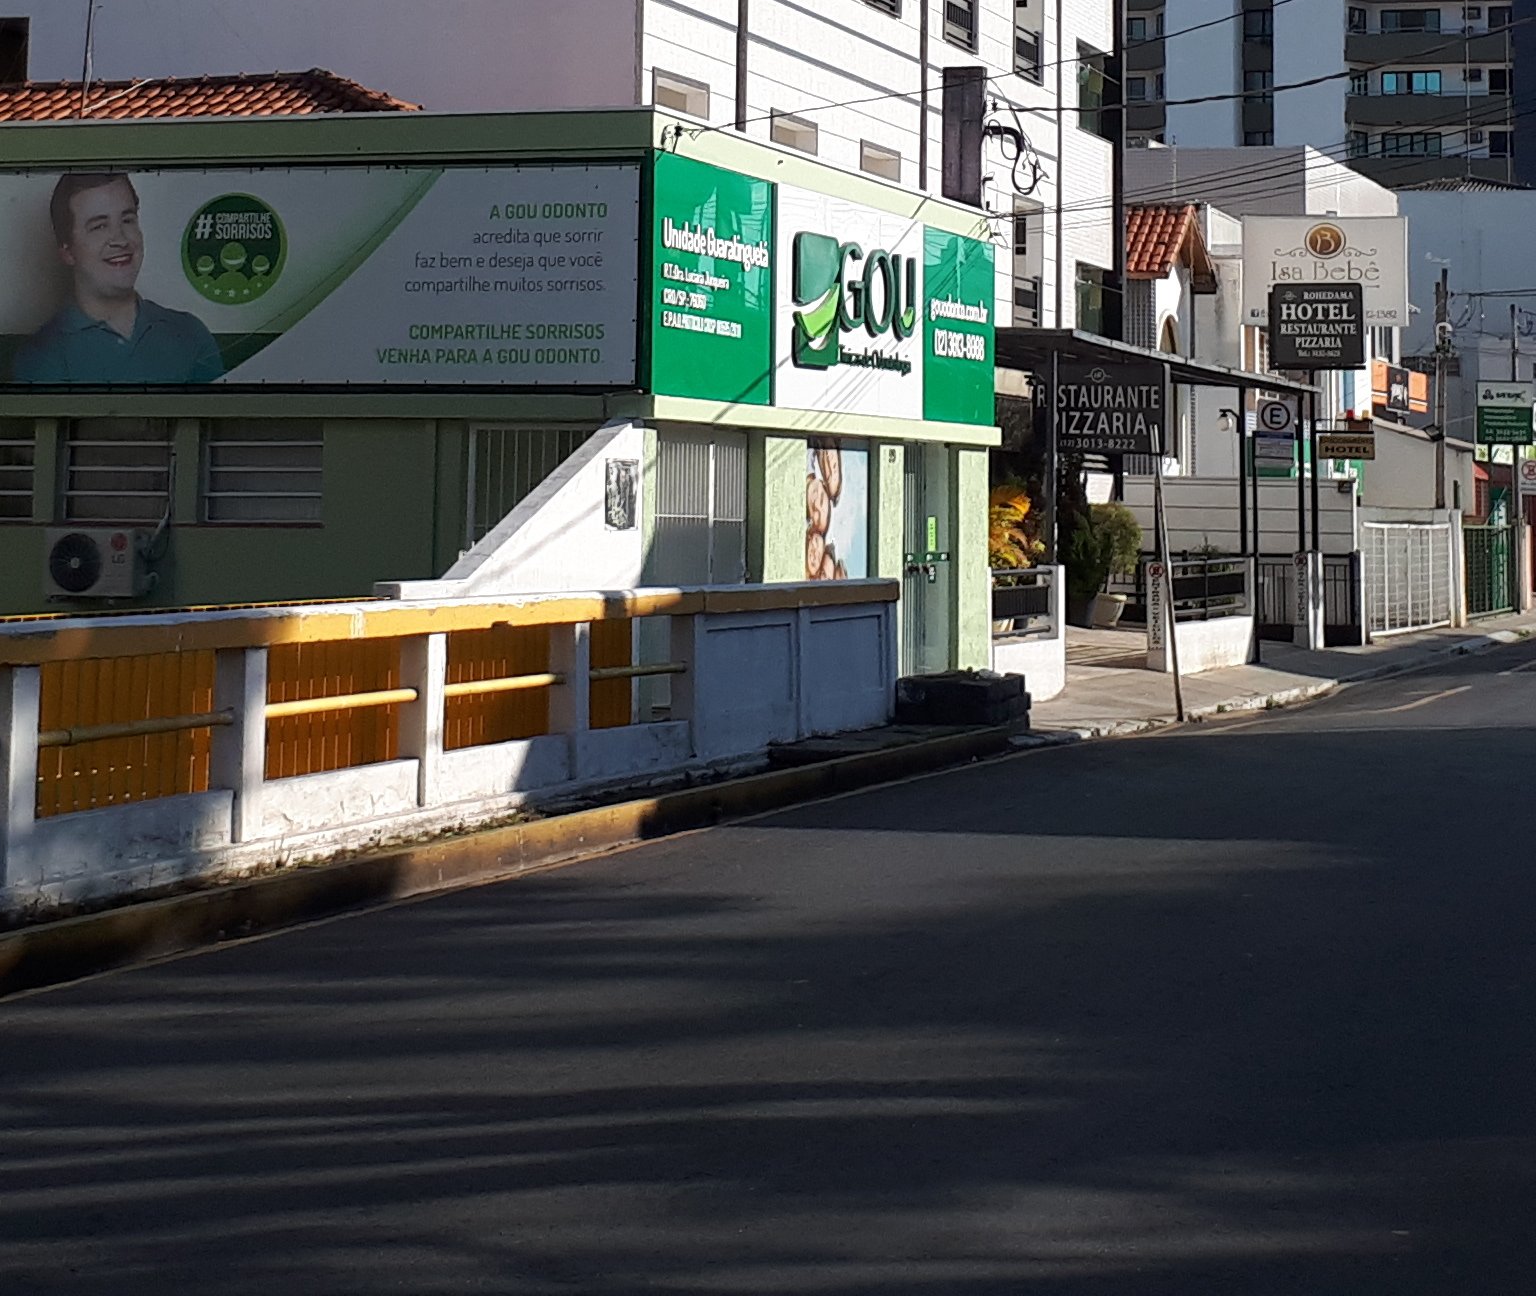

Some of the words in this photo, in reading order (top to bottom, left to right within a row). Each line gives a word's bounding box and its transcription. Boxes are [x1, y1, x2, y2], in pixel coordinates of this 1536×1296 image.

[215, 212, 272, 224] COMPARTILHE
[489, 205, 500, 219] A
[505, 203, 537, 219] GOU
[542, 203, 608, 219] ODONTO
[215, 223, 272, 240] SORRISOS
[473, 228, 530, 244] acredita
[534, 232, 561, 249] que
[565, 229, 604, 243] sorrir
[664, 217, 706, 254] Unidade
[415, 252, 436, 268] faz
[440, 251, 472, 268] bem
[476, 256, 485, 268] e
[489, 253, 534, 271] deseja
[538, 256, 565, 273] que
[570, 251, 603, 268] você
[1271, 261, 1304, 281] Isa
[1313, 260, 1380, 281] Bebê
[404, 276, 491, 295] compartilhe
[494, 276, 543, 292] muitos
[547, 277, 606, 292] sorrisos.
[839, 242, 916, 342] GOU
[1280, 303, 1357, 321] HOTEL
[409, 324, 522, 341] COMPARTILHE
[525, 323, 605, 340] SORRISOS
[1280, 323, 1357, 335] RESTAURANTE
[1295, 336, 1342, 348] PIZZARIA
[377, 348, 431, 364] VENHA
[436, 348, 478, 364] PARA
[482, 349, 493, 363] A
[497, 348, 530, 364] GOU
[535, 348, 605, 364] ODONTO.
[1037, 385, 1160, 409] RSTAURANTE
[1056, 412, 1148, 435] IZZARIA
[1076, 438, 1136, 450] 3013-8222
[1325, 446, 1370, 454] HOTEL
